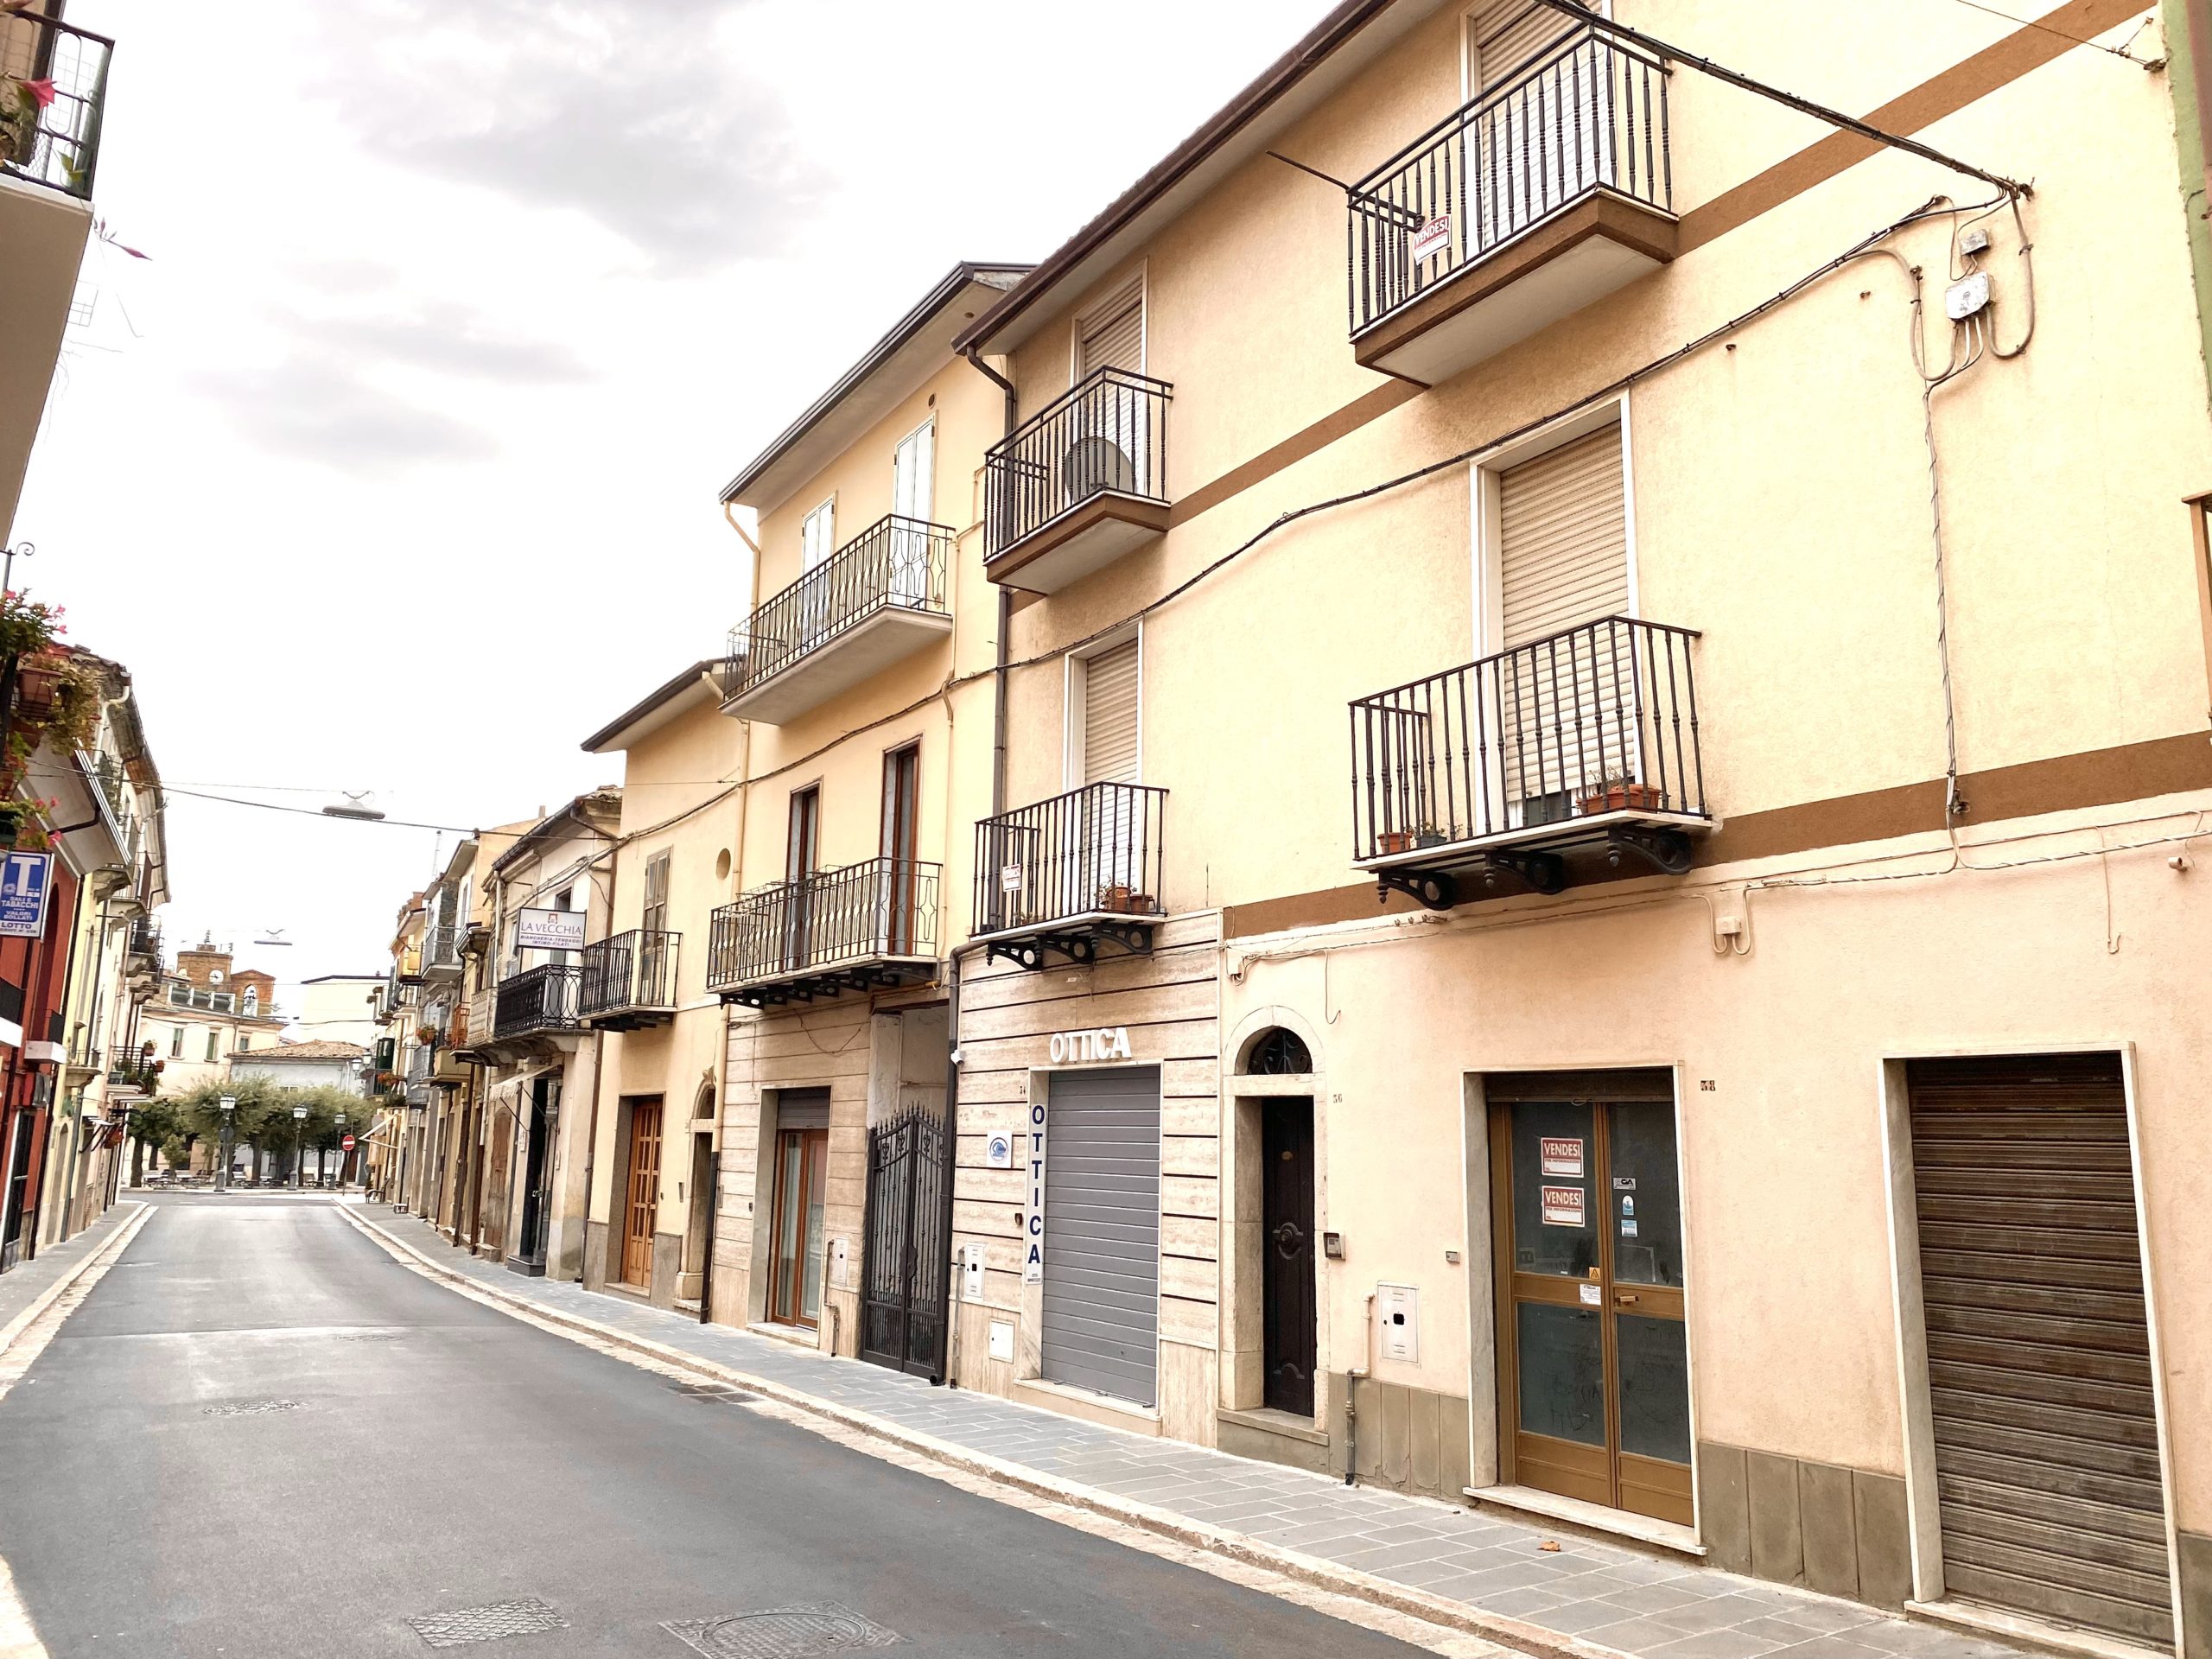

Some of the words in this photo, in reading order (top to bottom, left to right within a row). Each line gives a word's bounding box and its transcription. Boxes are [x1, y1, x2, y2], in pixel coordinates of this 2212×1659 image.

[1414, 218, 1449, 247] VENDESI
[10, 855, 41, 896] T
[2, 900, 39, 909] TABACCHI
[521, 922, 533, 931] LA
[536, 923, 582, 935] VECCHIA
[1050, 1027, 1132, 1063] OTTICA
[1543, 1142, 1581, 1157] VENDESI
[1027, 1104, 1046, 1264] OTTICA
[1545, 1191, 1582, 1206] VENDESI
